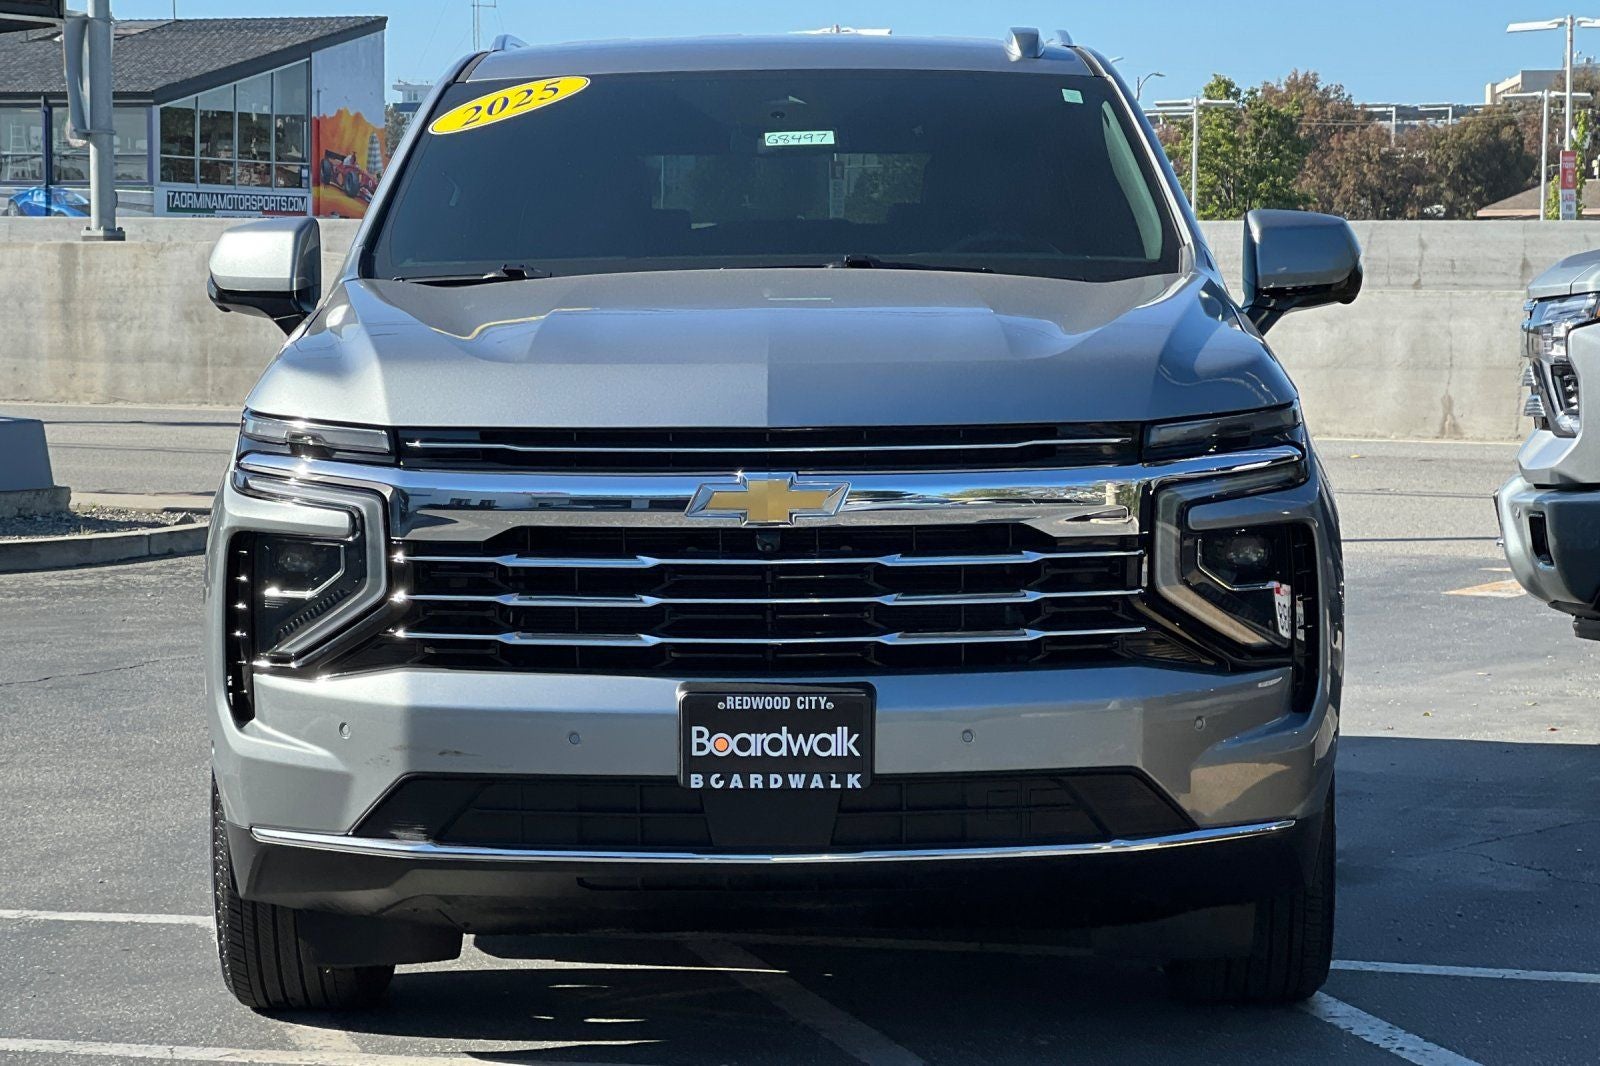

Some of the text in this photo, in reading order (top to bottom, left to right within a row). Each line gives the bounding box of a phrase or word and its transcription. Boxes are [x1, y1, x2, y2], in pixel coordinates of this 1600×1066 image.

[461, 80, 561, 127] 2025
[766, 133, 827, 144] G8497
[167, 191, 307, 211] TAORMINAMOTORSPORTS.COM
[726, 696, 827, 710] REDWOOD CITY
[691, 726, 861, 757] Boardwalk
[690, 773, 862, 789] BOARDWALK
